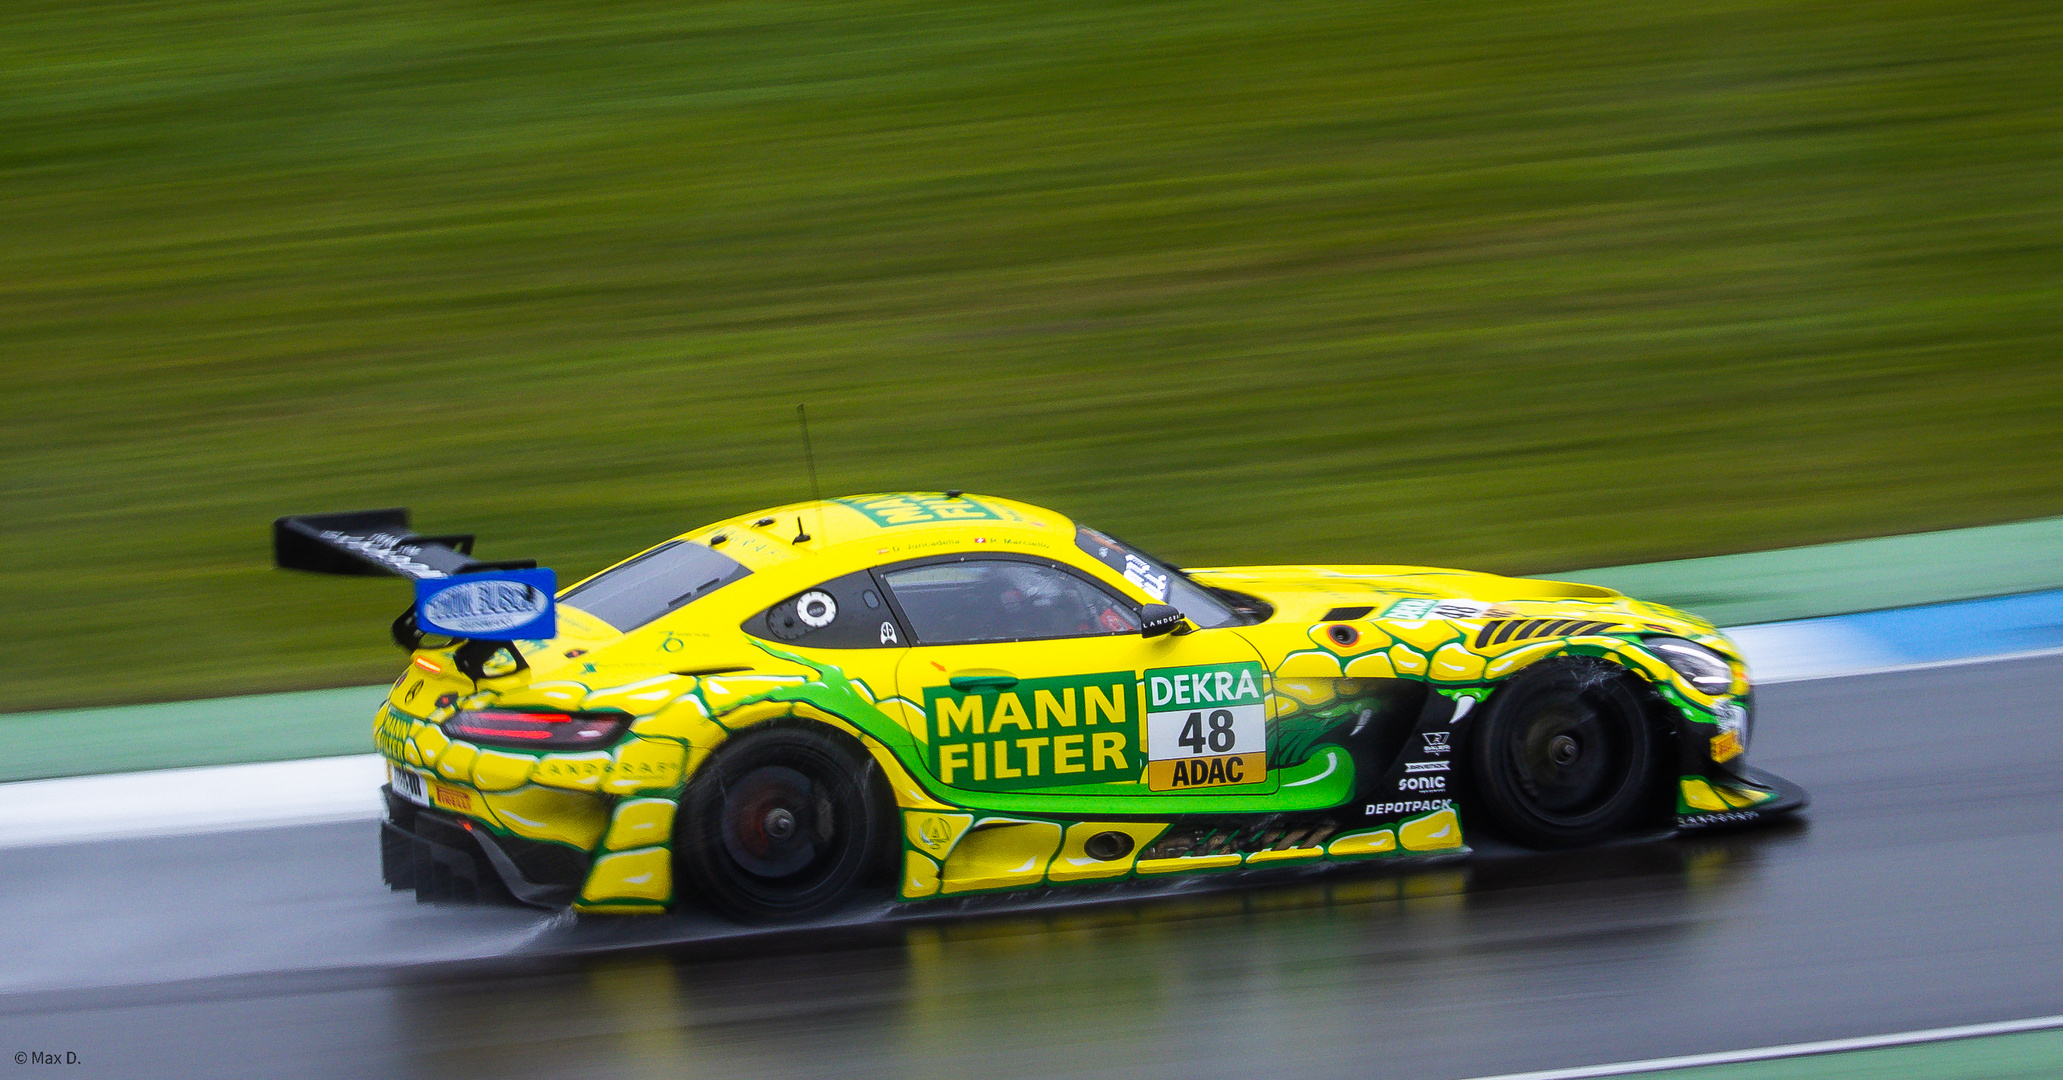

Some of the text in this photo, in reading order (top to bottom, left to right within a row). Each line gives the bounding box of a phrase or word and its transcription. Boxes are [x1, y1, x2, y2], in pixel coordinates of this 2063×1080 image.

[1150, 669, 1261, 707] DEKRA
[935, 683, 1126, 738] MANN
[1178, 709, 1236, 754] 48
[939, 731, 1129, 784] FILTER
[1172, 757, 1245, 788] ADAC
[1365, 799, 1452, 815] DEPOTPACK
